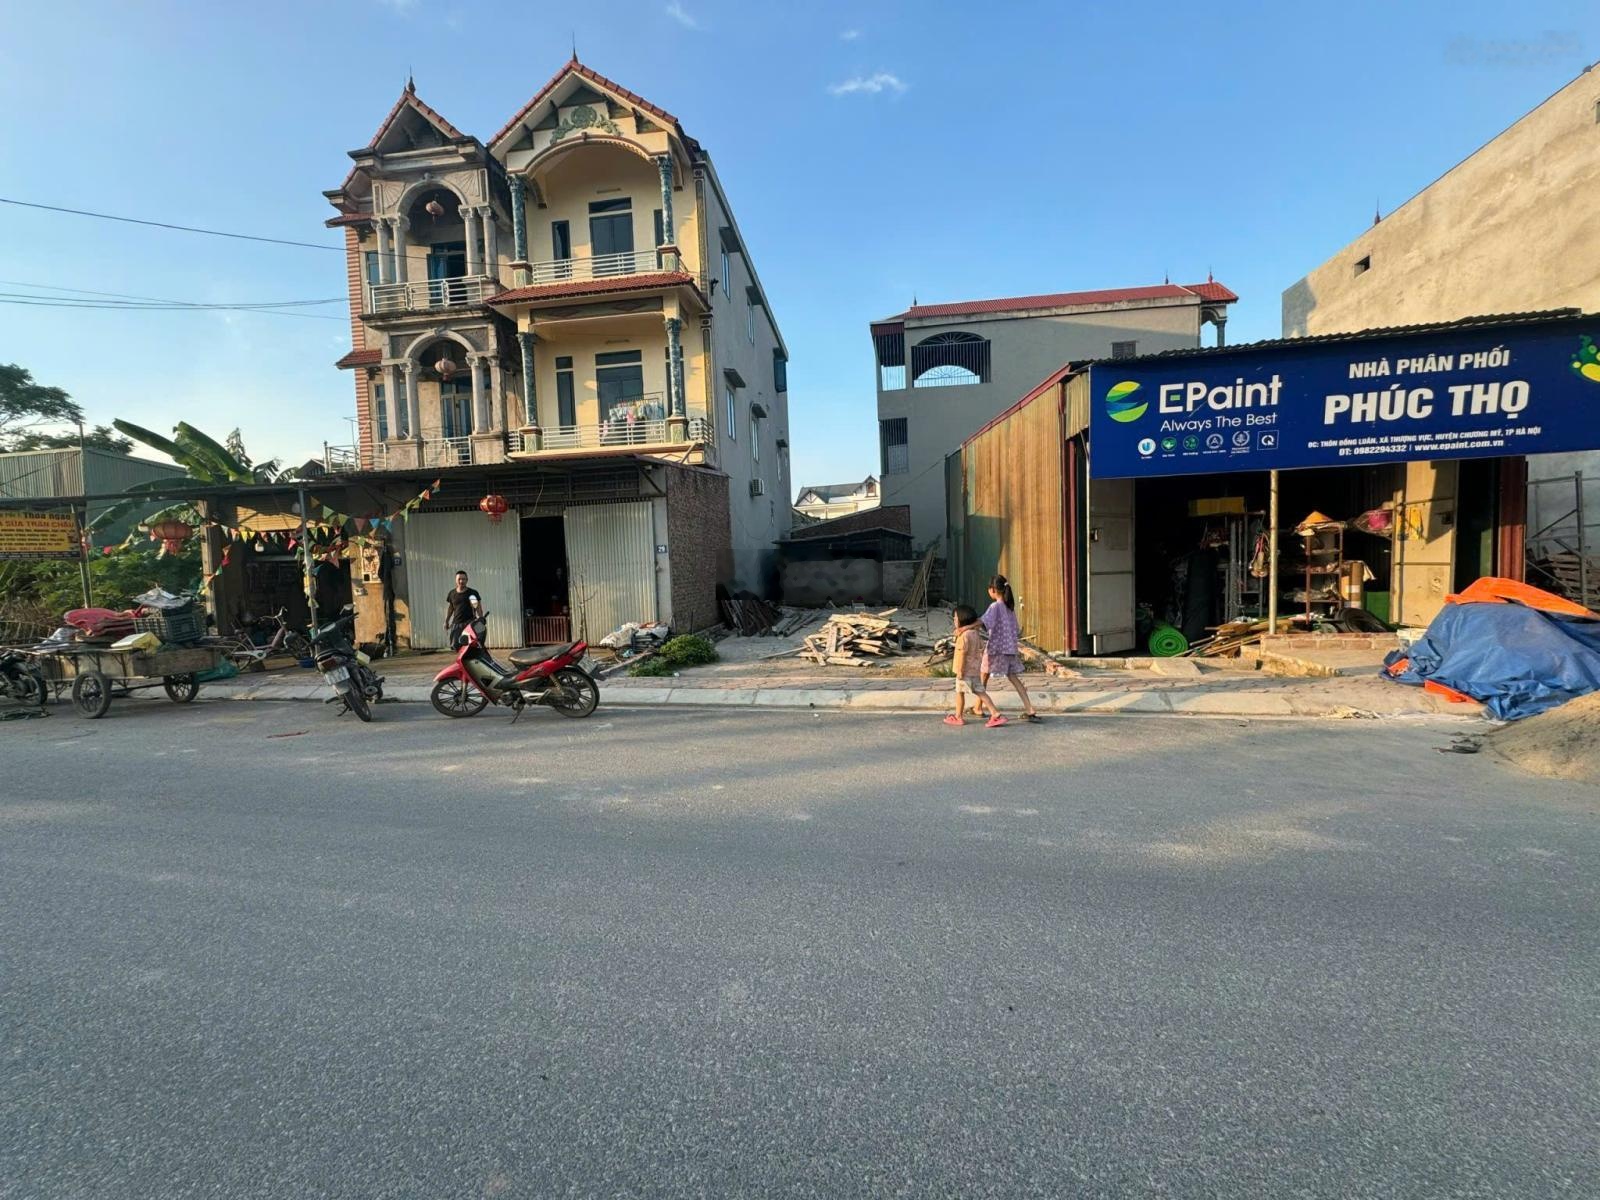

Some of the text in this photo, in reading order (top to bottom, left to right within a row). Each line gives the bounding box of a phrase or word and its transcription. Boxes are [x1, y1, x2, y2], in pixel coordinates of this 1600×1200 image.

[1349, 345, 1510, 379] NHÀ PHÂN PHỐI
[1159, 374, 1283, 413] EPaint
[1324, 380, 1530, 425] PHÚC THỌ
[1160, 412, 1278, 433] Always The Best
[1321, 439, 1338, 448] THÔN
[1379, 435, 1389, 444] XÃ
[1390, 434, 1417, 443] THƯỢNG
[1435, 430, 1458, 440] HUYỆN
[1460, 430, 1488, 439] CHƯƠNG
[1506, 428, 1514, 436] TP
[1516, 426, 1526, 435] HÀ
[1528, 426, 1541, 435] NỘI
[1354, 445, 1407, 455] 0982294332
[1415, 439, 1504, 452] www.epaint.com.vn
